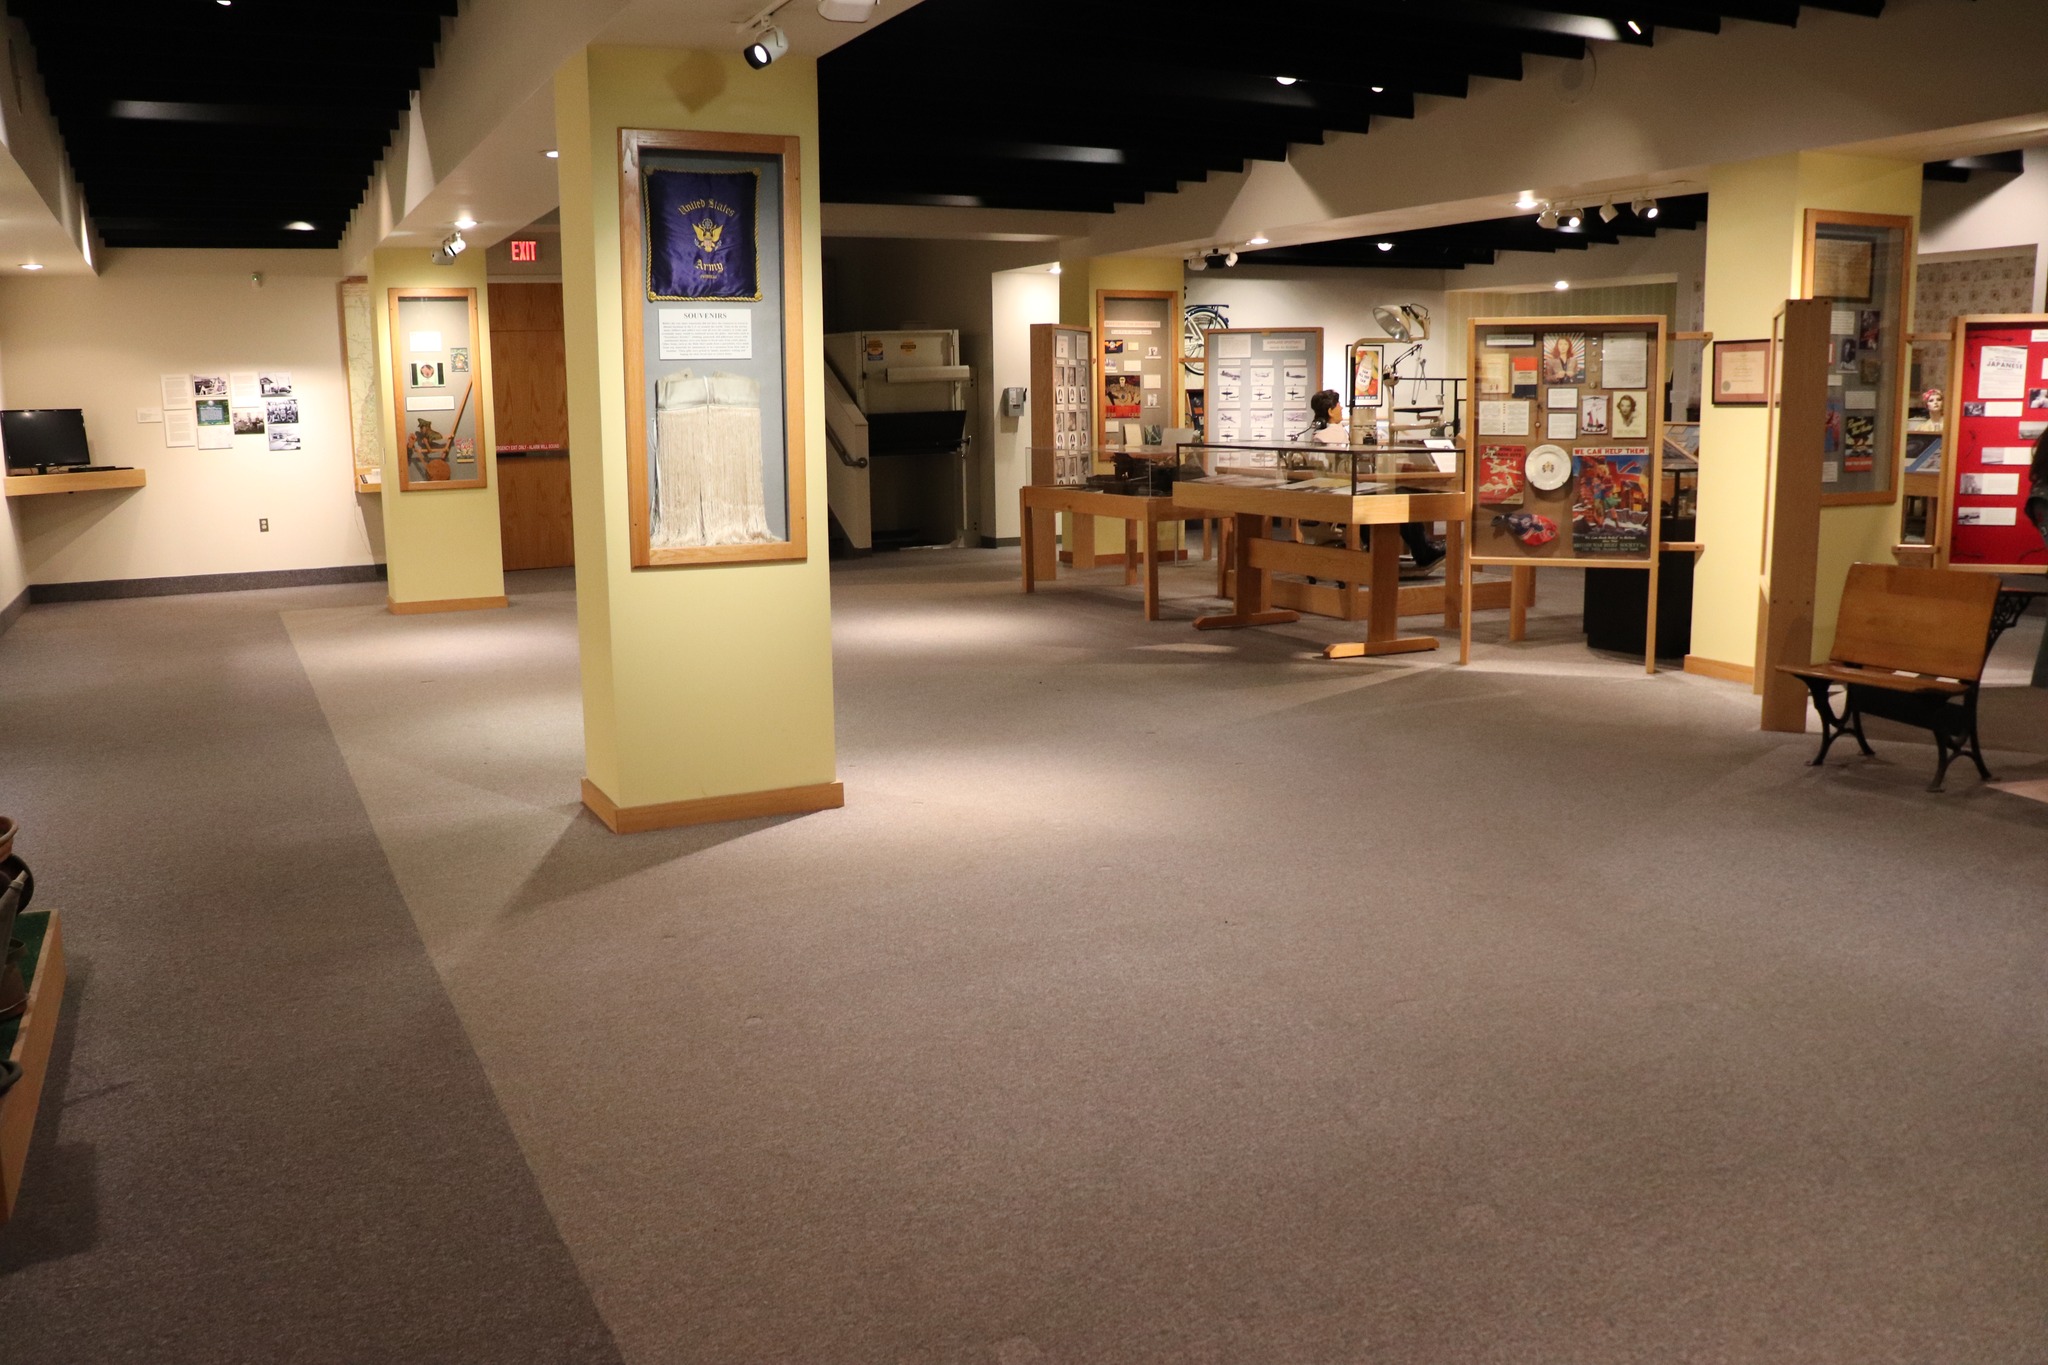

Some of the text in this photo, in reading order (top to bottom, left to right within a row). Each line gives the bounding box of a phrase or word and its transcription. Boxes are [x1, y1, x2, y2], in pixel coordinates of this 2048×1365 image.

[678, 198, 736, 217] United States
[511, 241, 536, 261] EXIT
[695, 258, 724, 273] Army
[1987, 360, 2022, 369] JAPANESE
